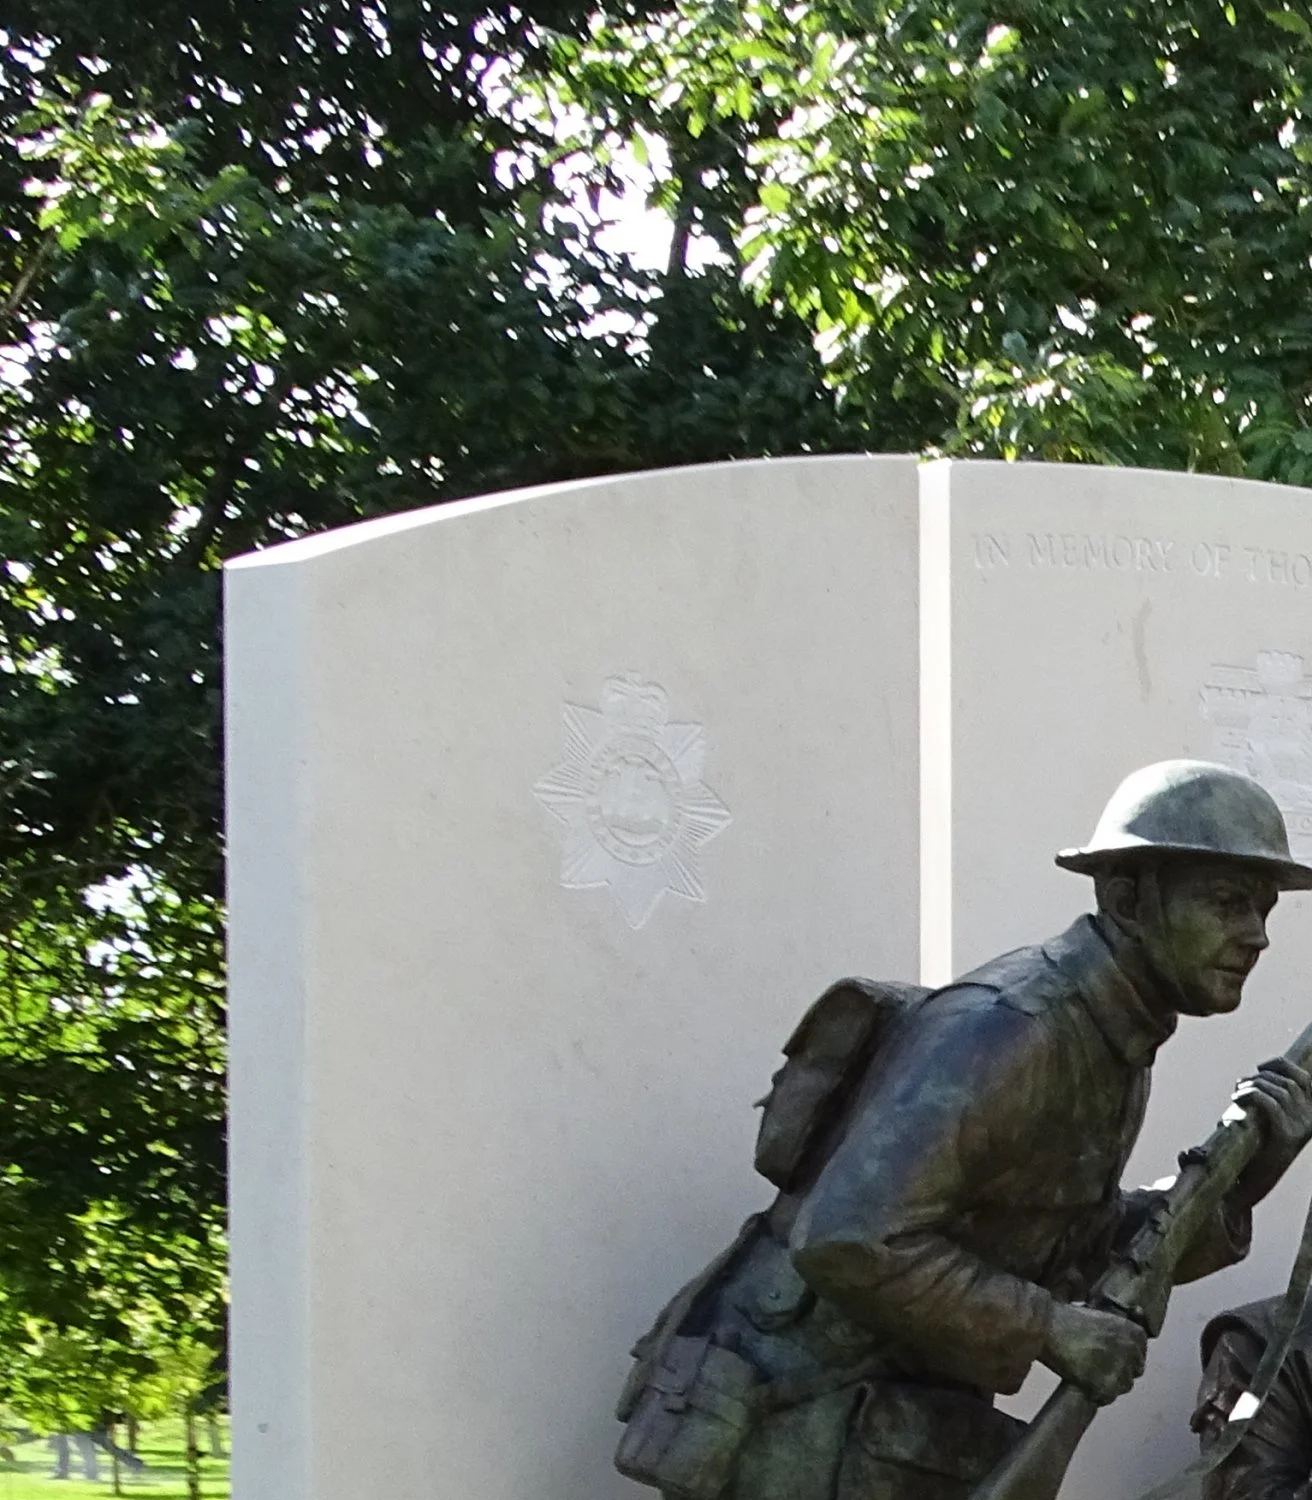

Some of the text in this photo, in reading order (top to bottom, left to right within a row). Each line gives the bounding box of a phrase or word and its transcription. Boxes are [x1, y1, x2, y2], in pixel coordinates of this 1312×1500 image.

[971, 533, 1010, 570] IN
[1026, 531, 1173, 573] MEMORY
[1191, 539, 1231, 579] OF
